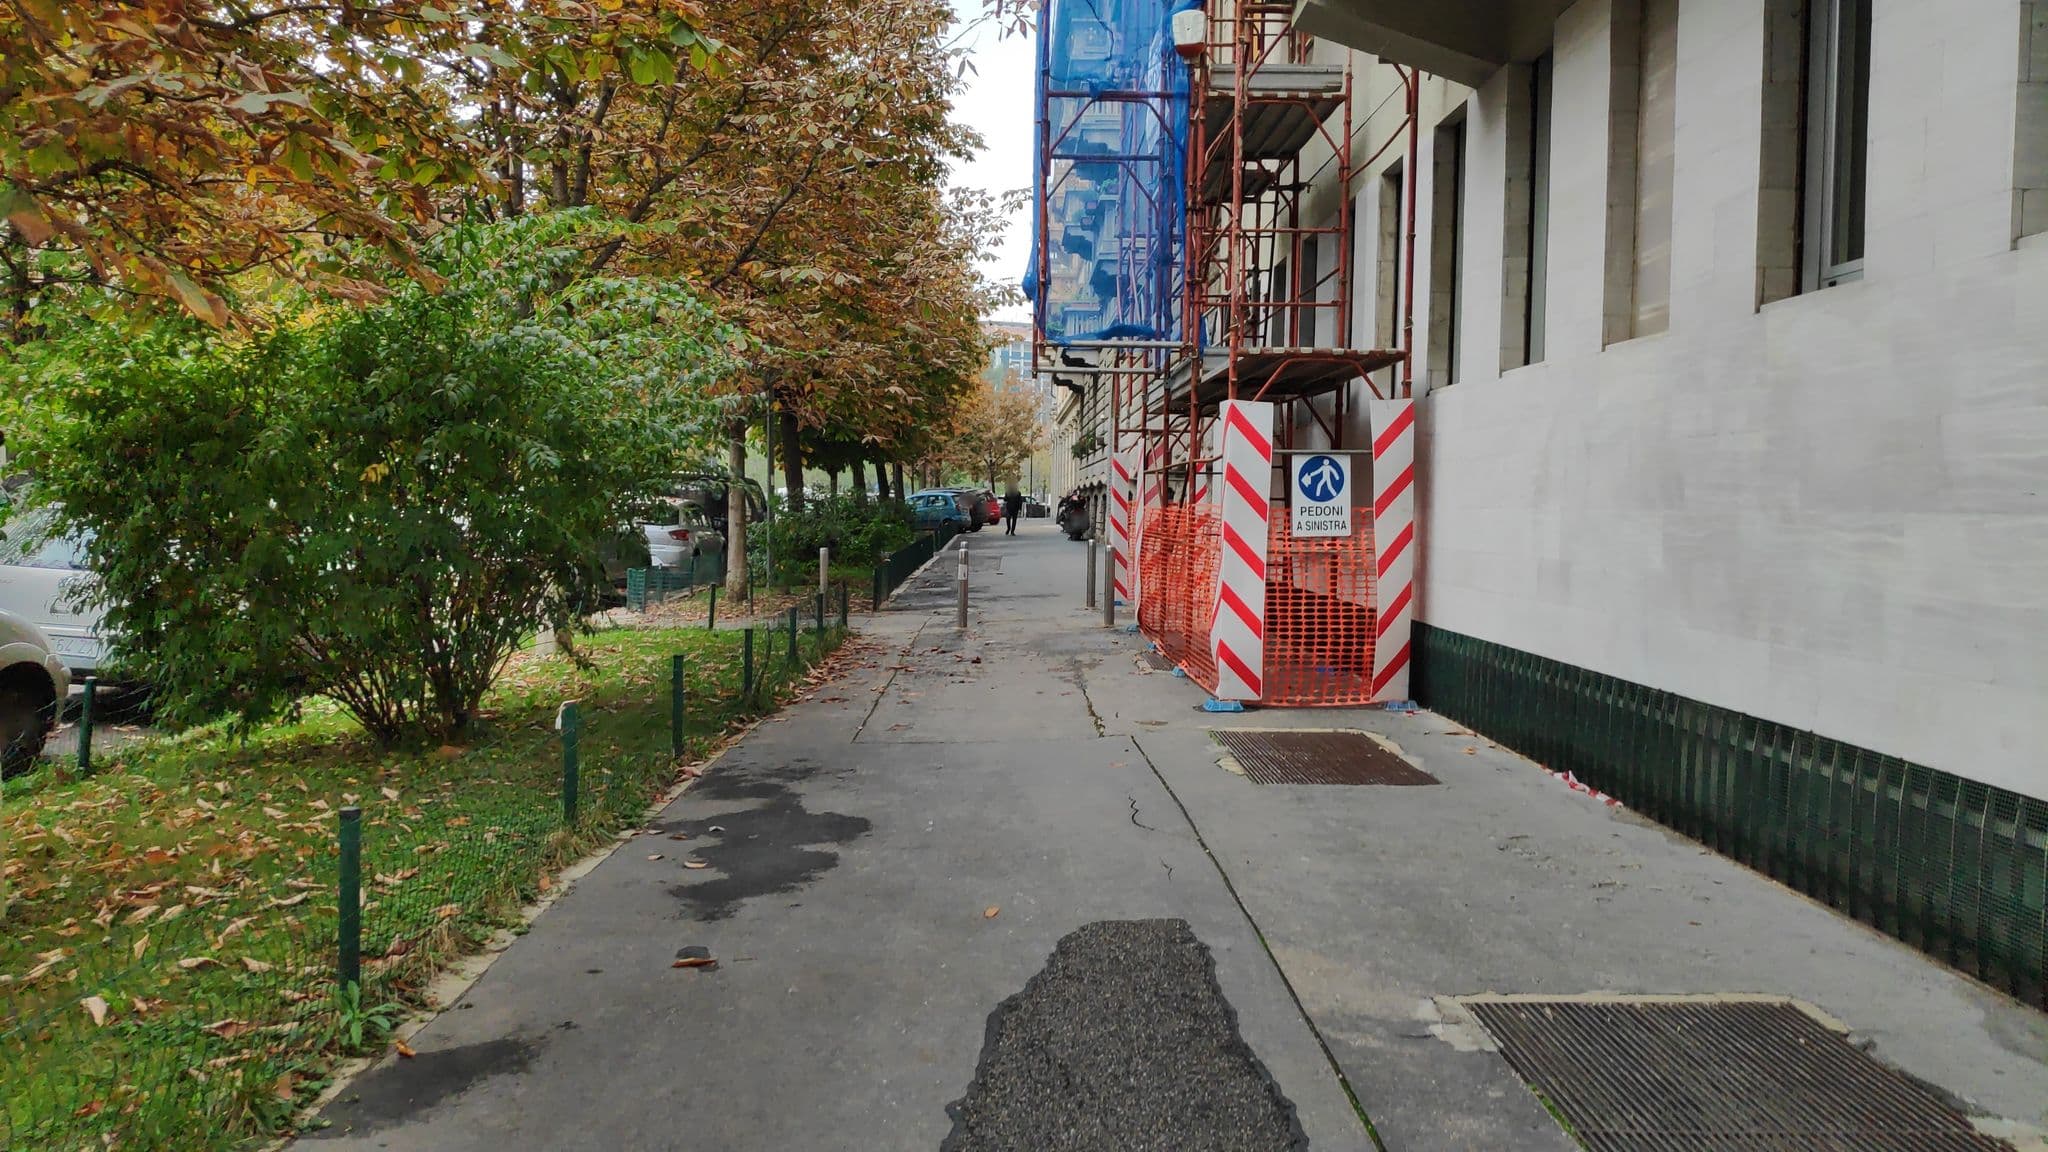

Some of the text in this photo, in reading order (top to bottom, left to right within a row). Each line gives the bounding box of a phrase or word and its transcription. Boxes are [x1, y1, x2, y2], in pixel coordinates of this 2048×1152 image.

[1300, 505, 1343, 516] PEDONI
[1297, 520, 1347, 531] A SINISTRA
